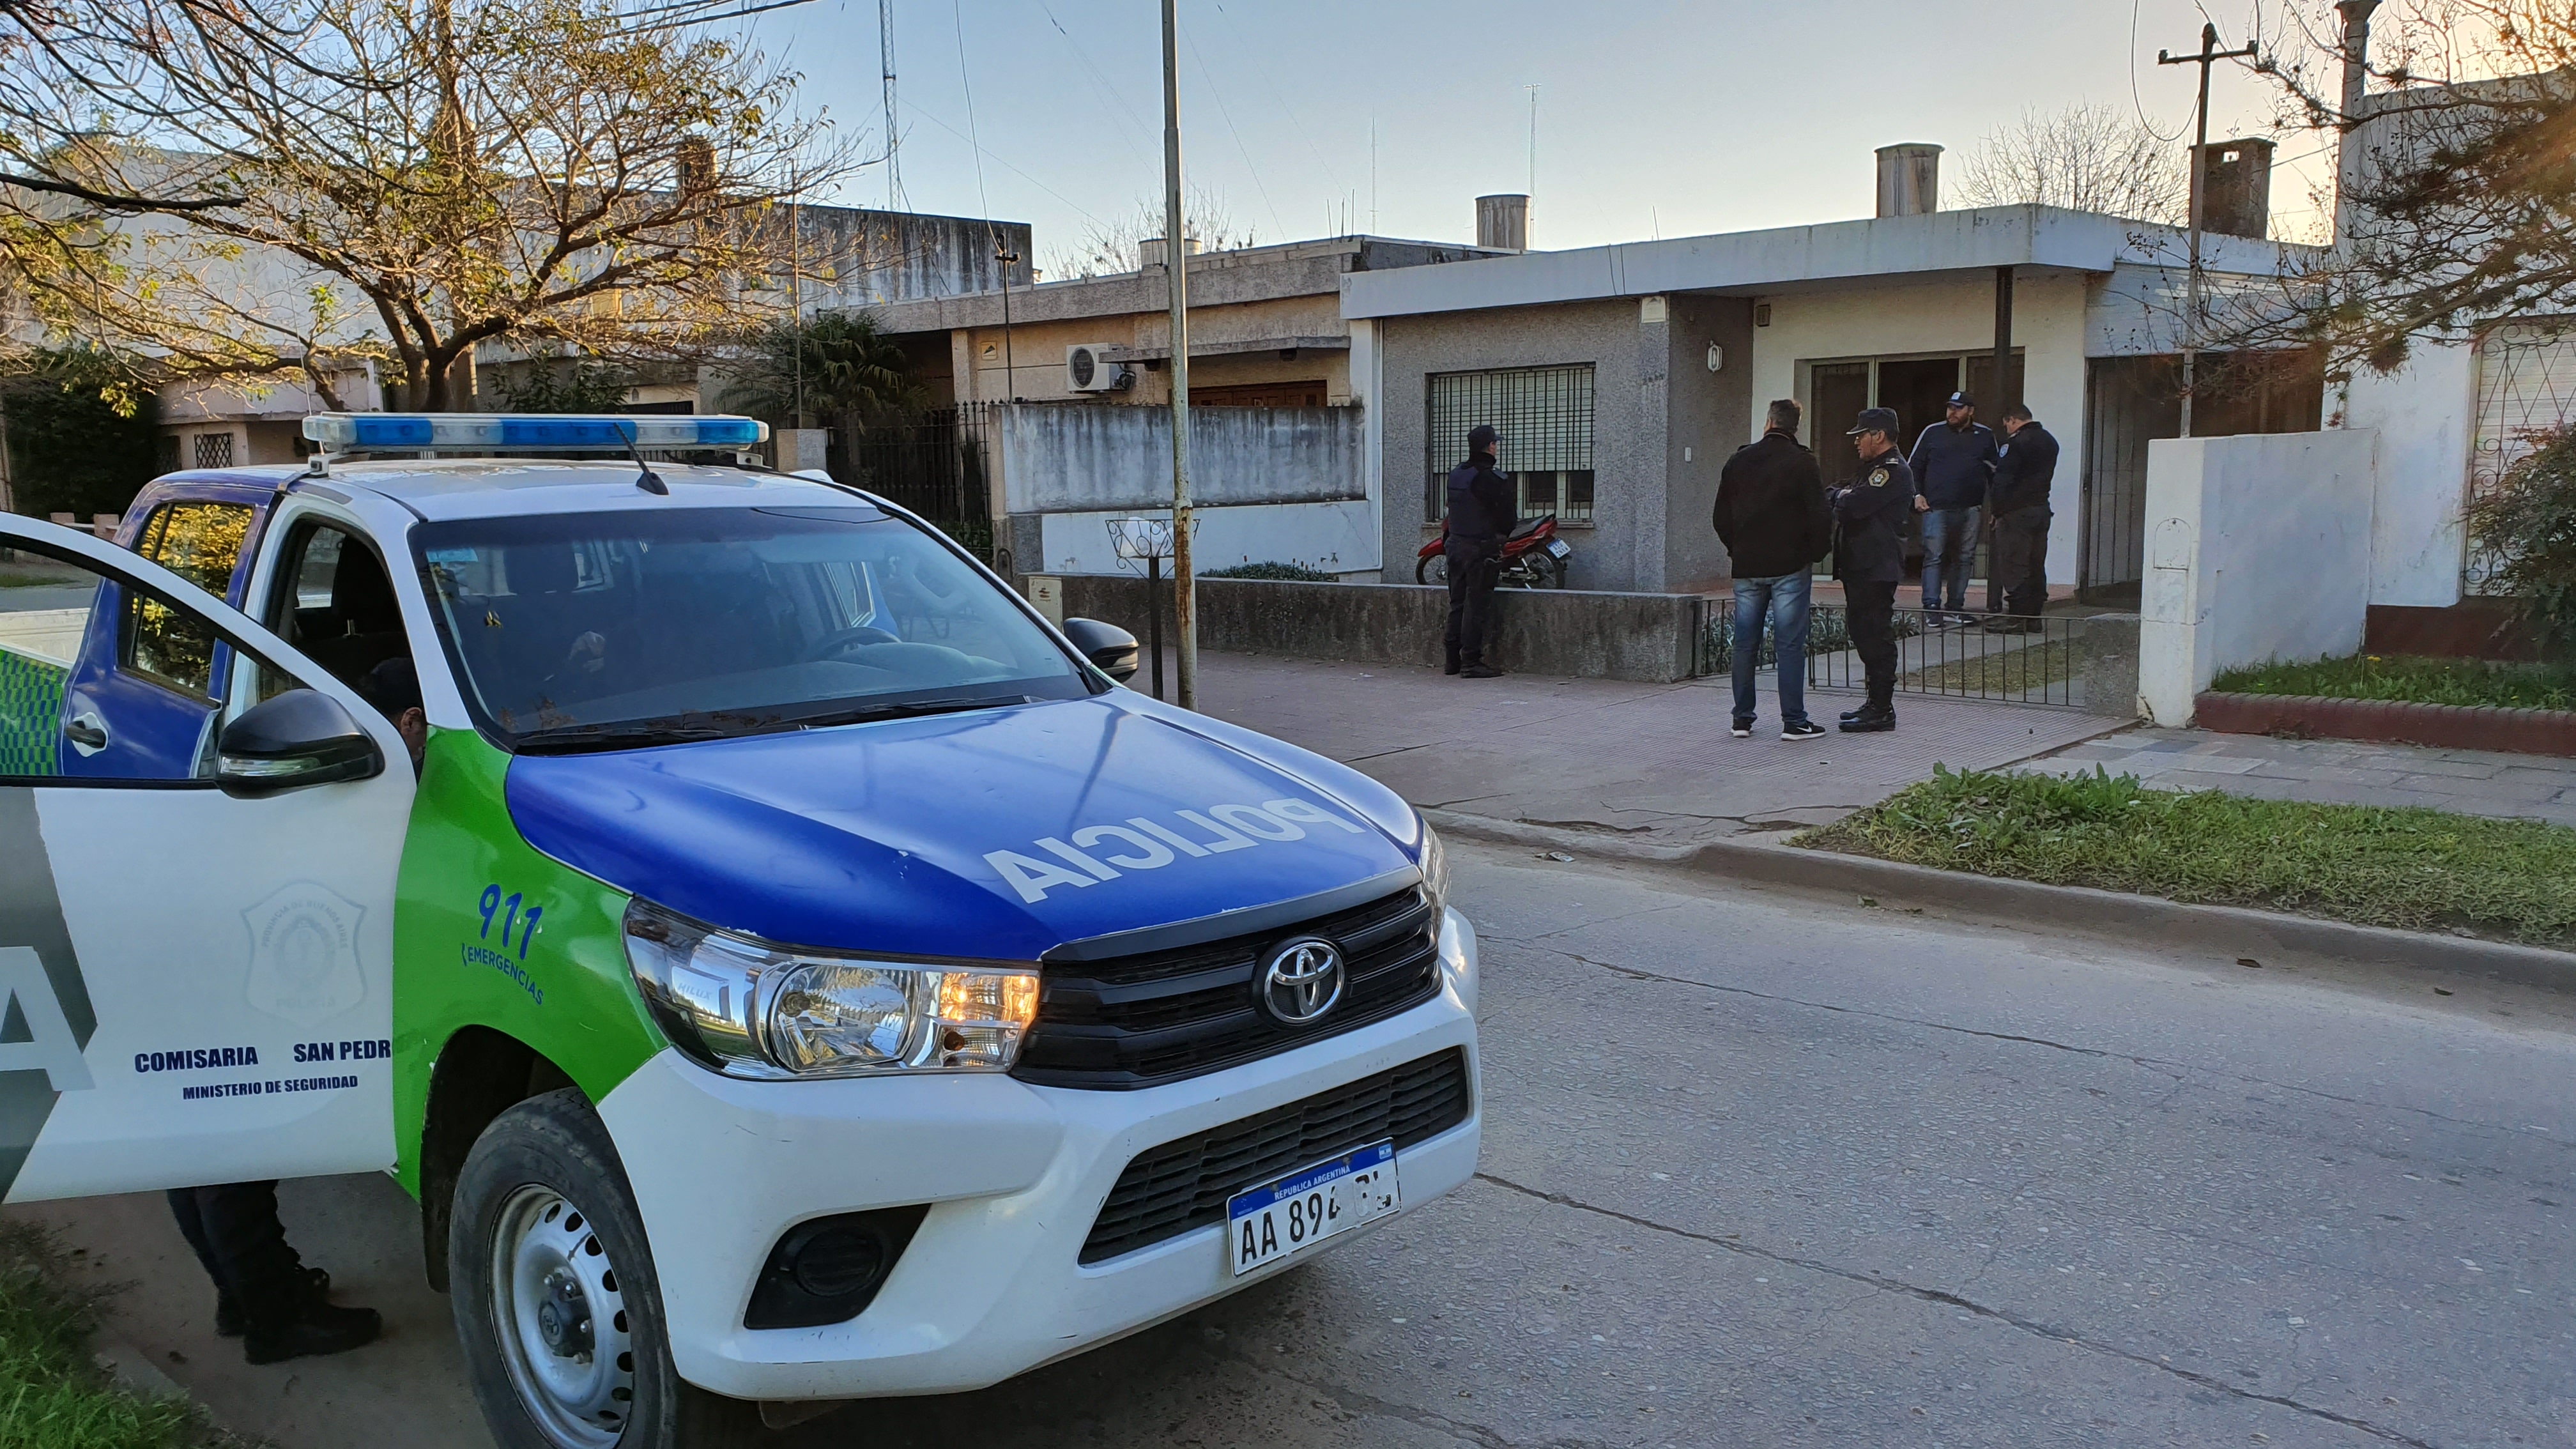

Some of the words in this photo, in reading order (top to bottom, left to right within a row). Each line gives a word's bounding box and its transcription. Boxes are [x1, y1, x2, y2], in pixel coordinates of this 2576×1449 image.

[479, 883, 543, 960] 911
[467, 946, 543, 1005] EMERGENCIAS
[134, 1046, 258, 1073] COMISARIA
[293, 1042, 335, 1062] SAN
[183, 1082, 262, 1100] MINISTERIO
[265, 1080, 282, 1094] DE
[284, 1075, 358, 1092] SEGURIDAD
[1273, 1181, 1312, 1201] REPUBLICA
[1313, 1165, 1351, 1186] ARGENTINA
[1241, 1211, 1278, 1265] AA
